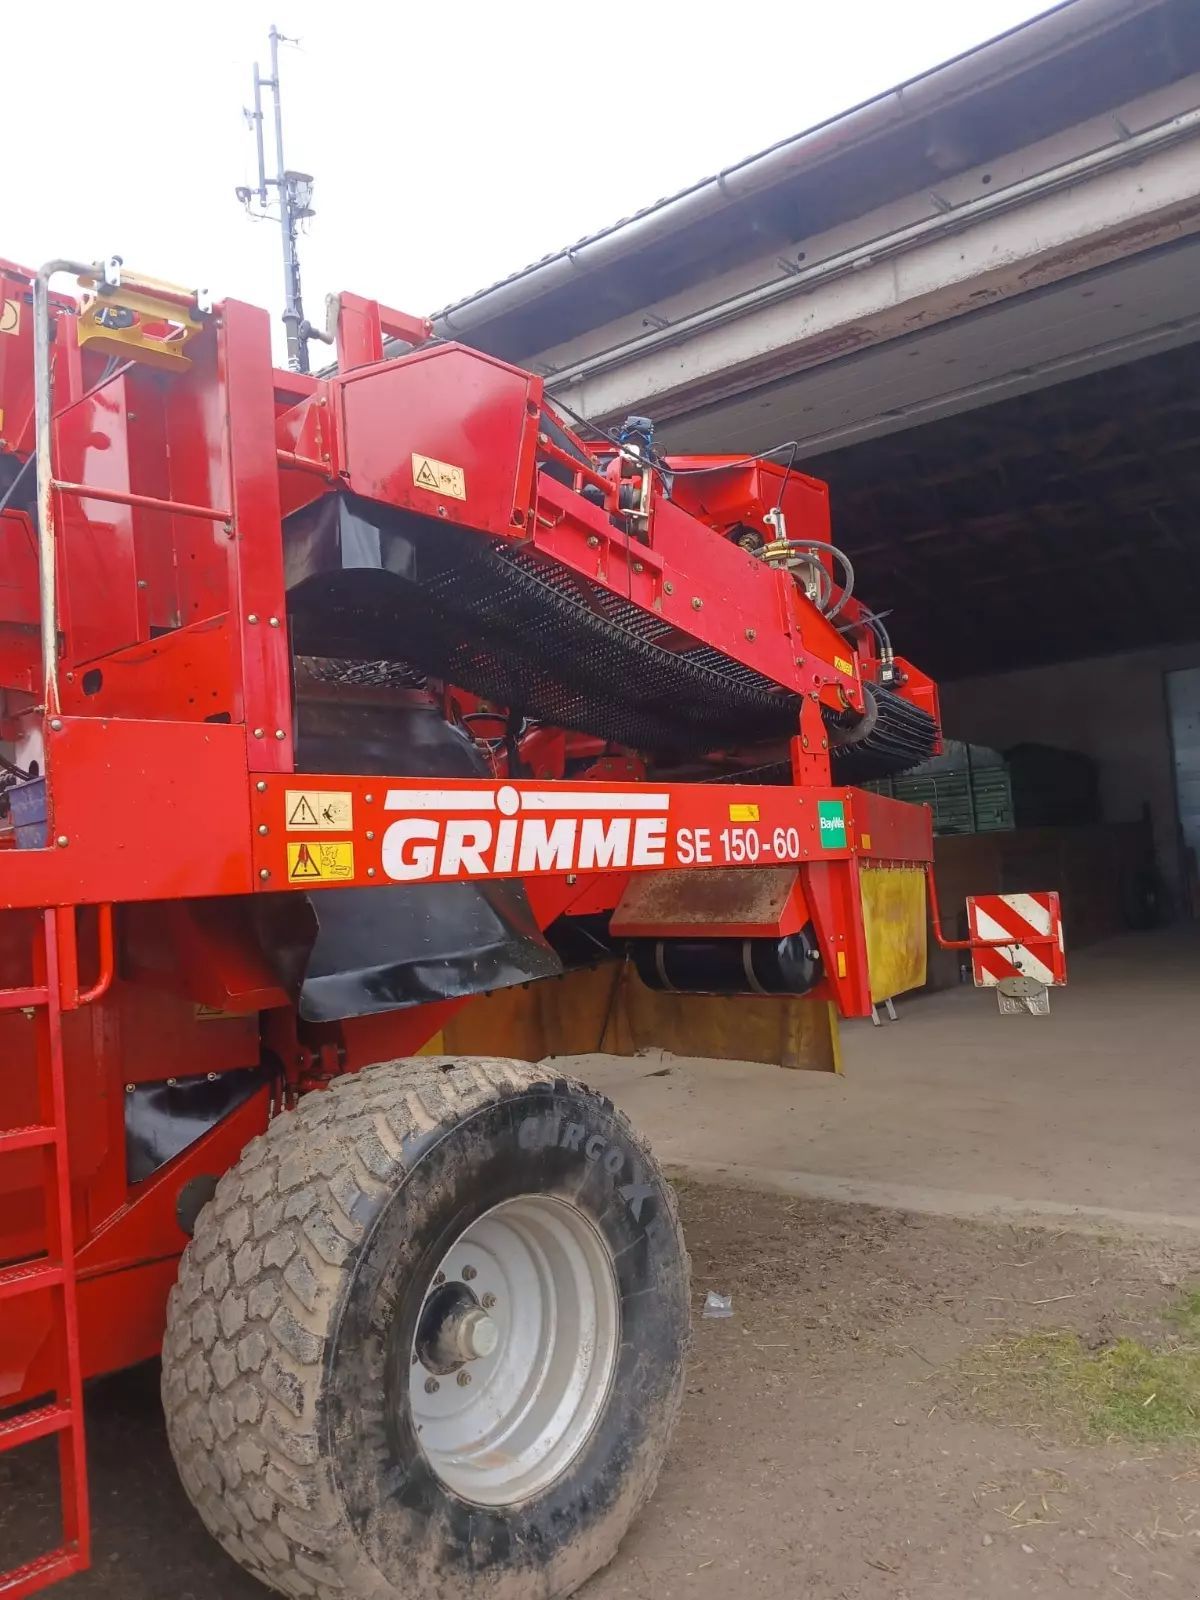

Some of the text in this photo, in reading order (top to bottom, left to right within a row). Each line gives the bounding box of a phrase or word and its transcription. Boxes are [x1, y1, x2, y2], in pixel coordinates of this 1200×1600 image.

[381, 785, 669, 881] GRIMME
[819, 817, 845, 831] BayWa
[675, 827, 800, 864] SE 150-60
